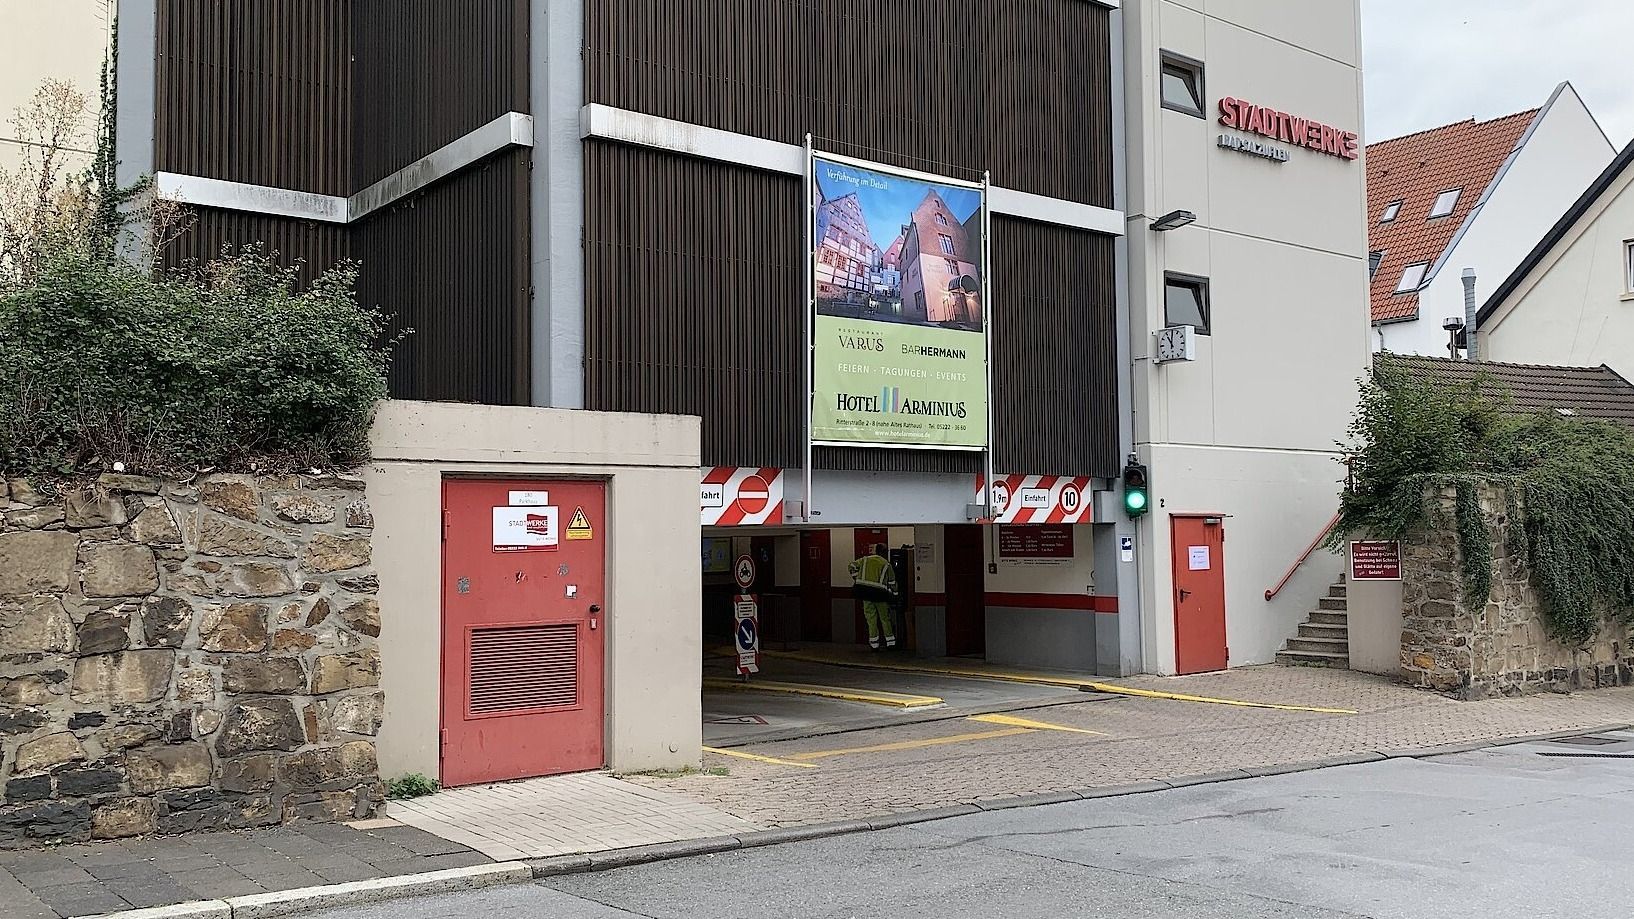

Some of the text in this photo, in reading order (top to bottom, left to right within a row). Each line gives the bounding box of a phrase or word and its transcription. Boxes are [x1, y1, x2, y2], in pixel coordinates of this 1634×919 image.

[1219, 97, 1358, 160] STADTWERKE
[827, 168, 888, 190] Verführung im Detail
[838, 335, 884, 352] VARUS
[838, 363, 967, 382] FEIERN TAGUNGEN EVENTS
[837, 393, 967, 419] HOTEL ARMINIUS
[1024, 494, 1046, 502] Einfahrt
[1064, 491, 1076, 507] 10
[1160, 497, 1165, 508] 2
[508, 519, 548, 528] STADTWERKE
